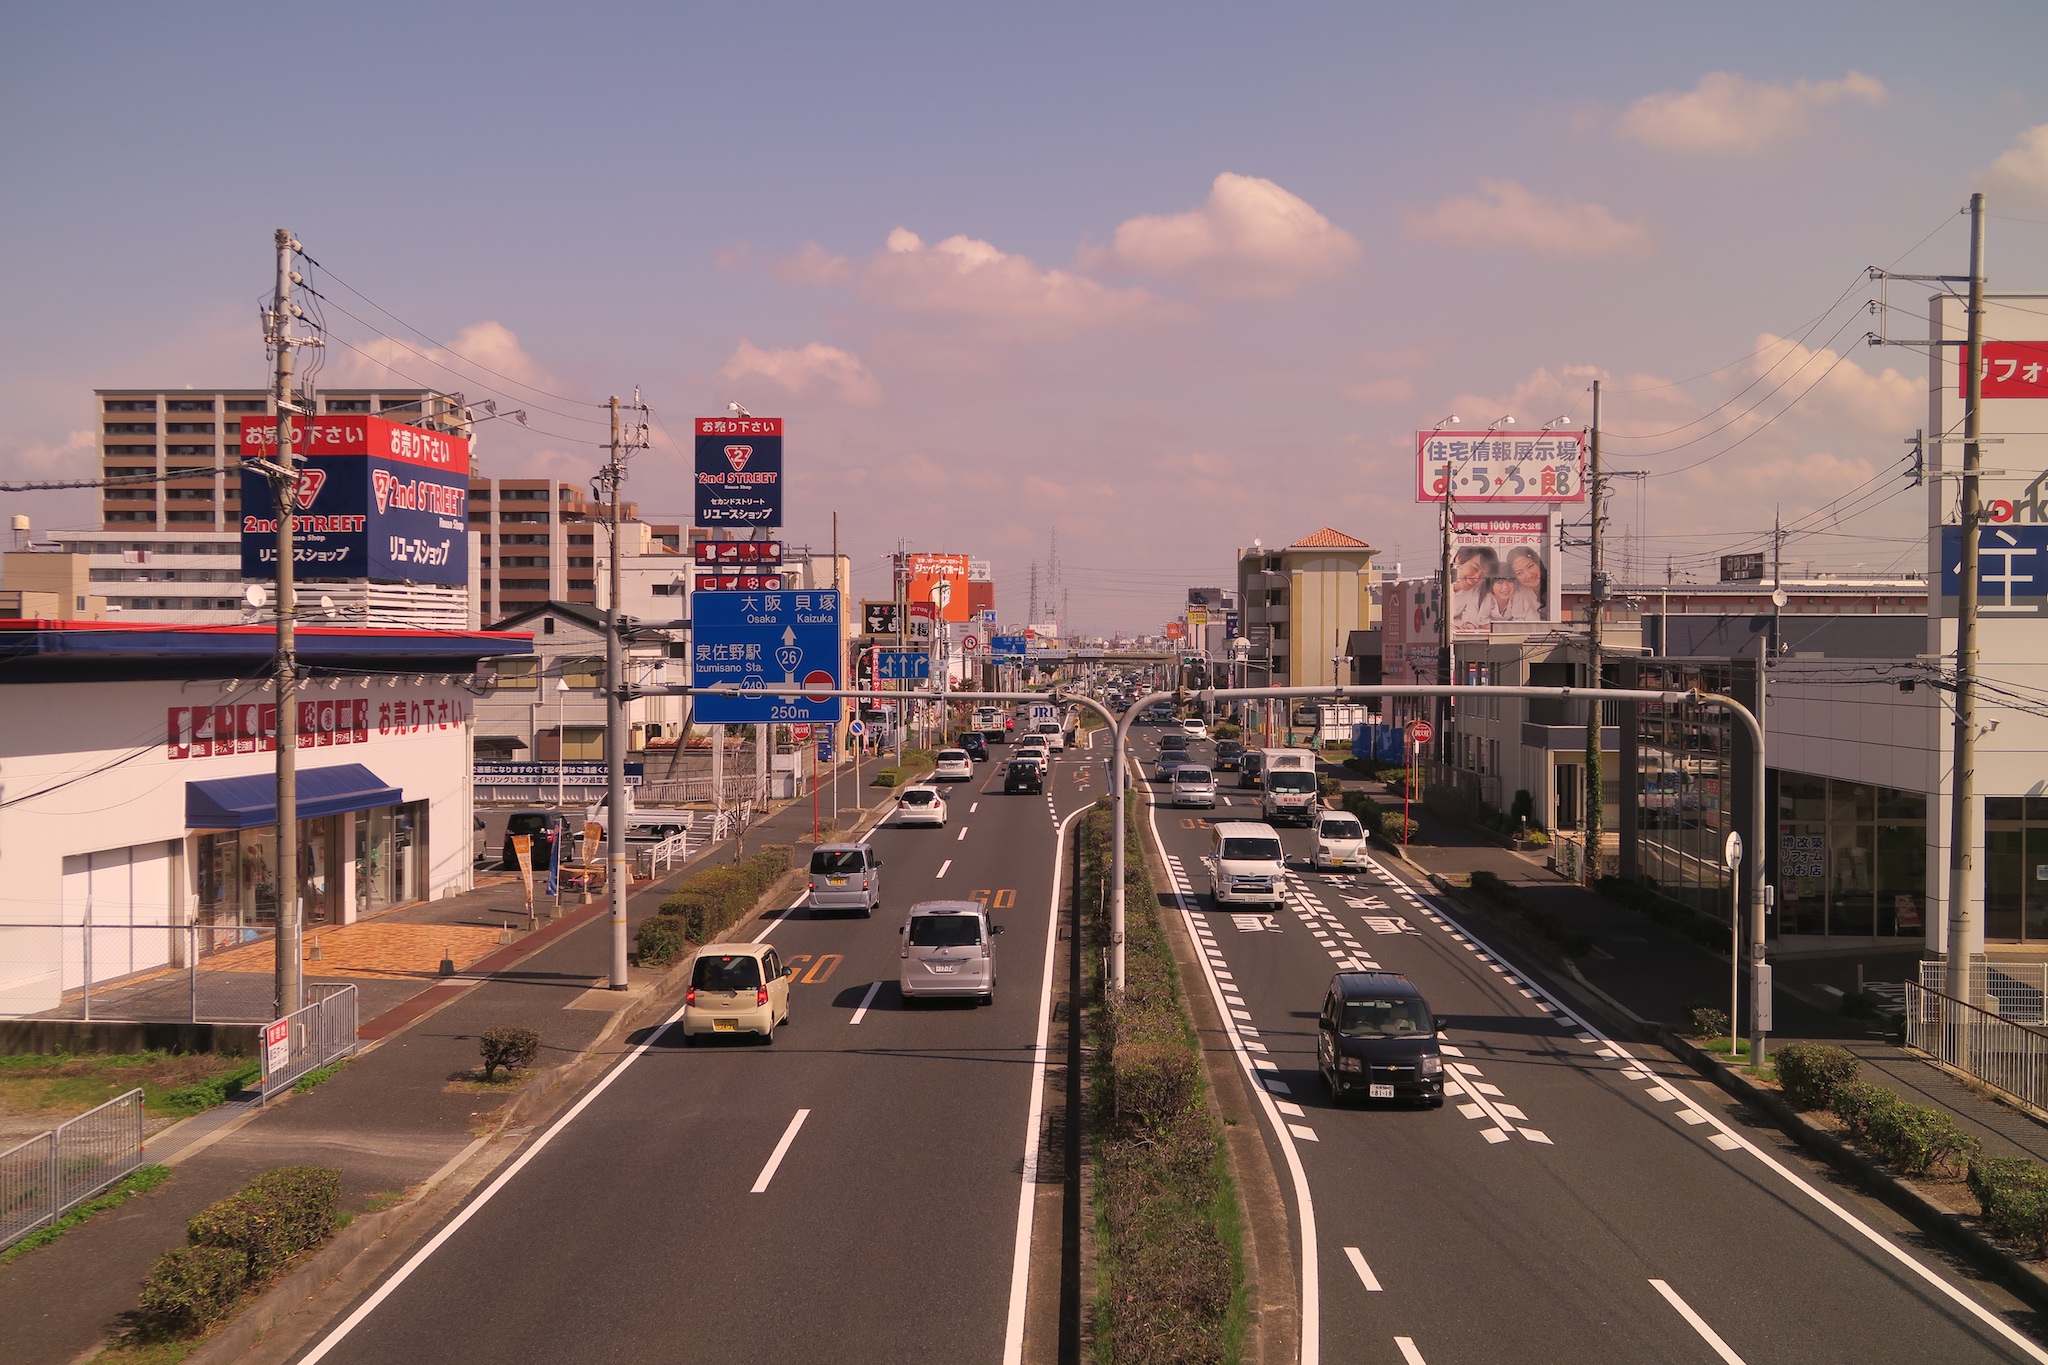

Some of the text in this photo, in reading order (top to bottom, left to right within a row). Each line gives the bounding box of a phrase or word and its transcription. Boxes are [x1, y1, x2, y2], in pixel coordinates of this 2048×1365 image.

[702, 420, 775, 433] お売り下さい
[390, 428, 450, 463] お売り下さい
[1427, 441, 1577, 462] 住宅情報展示場
[699, 472, 778, 484] 2nd STREET
[390, 475, 465, 518] 2nd STREET
[711, 498, 766, 506] セカンドストリート
[703, 507, 773, 520] リユースショップ
[291, 515, 367, 533] STREET
[453, 520, 465, 533] Shop
[307, 534, 326, 543] Shop
[390, 536, 450, 567] リユースショップ
[741, 594, 836, 612] 大阪 貝塚
[747, 613, 834, 623] Osaka Kaizuka
[696, 643, 762, 661] 泉佐野駅
[781, 651, 797, 664] 26
[696, 662, 763, 673] Izumisano Sta.
[378, 699, 463, 737] お売り下さい
[770, 705, 810, 719] 250m
[1781, 835, 1825, 849] 増改築
[1781, 849, 1824, 862] リフォーム
[1782, 864, 1823, 877] のお店
